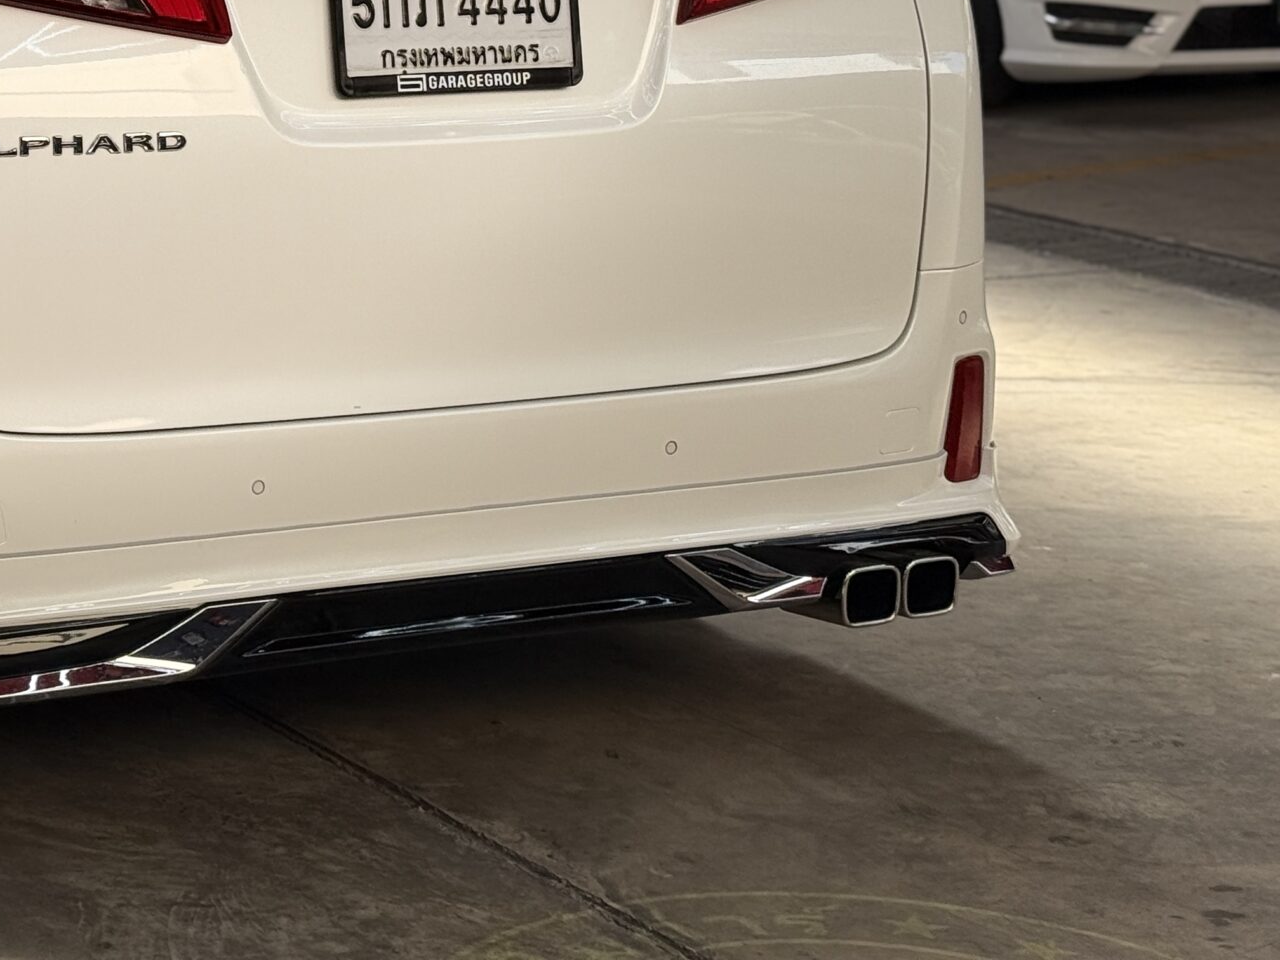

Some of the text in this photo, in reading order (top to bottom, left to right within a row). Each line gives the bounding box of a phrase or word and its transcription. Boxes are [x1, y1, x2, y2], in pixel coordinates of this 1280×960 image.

[380, 43, 540, 74] กรุงเทพมหานคร
[427, 71, 532, 90] GARAGEGROUP
